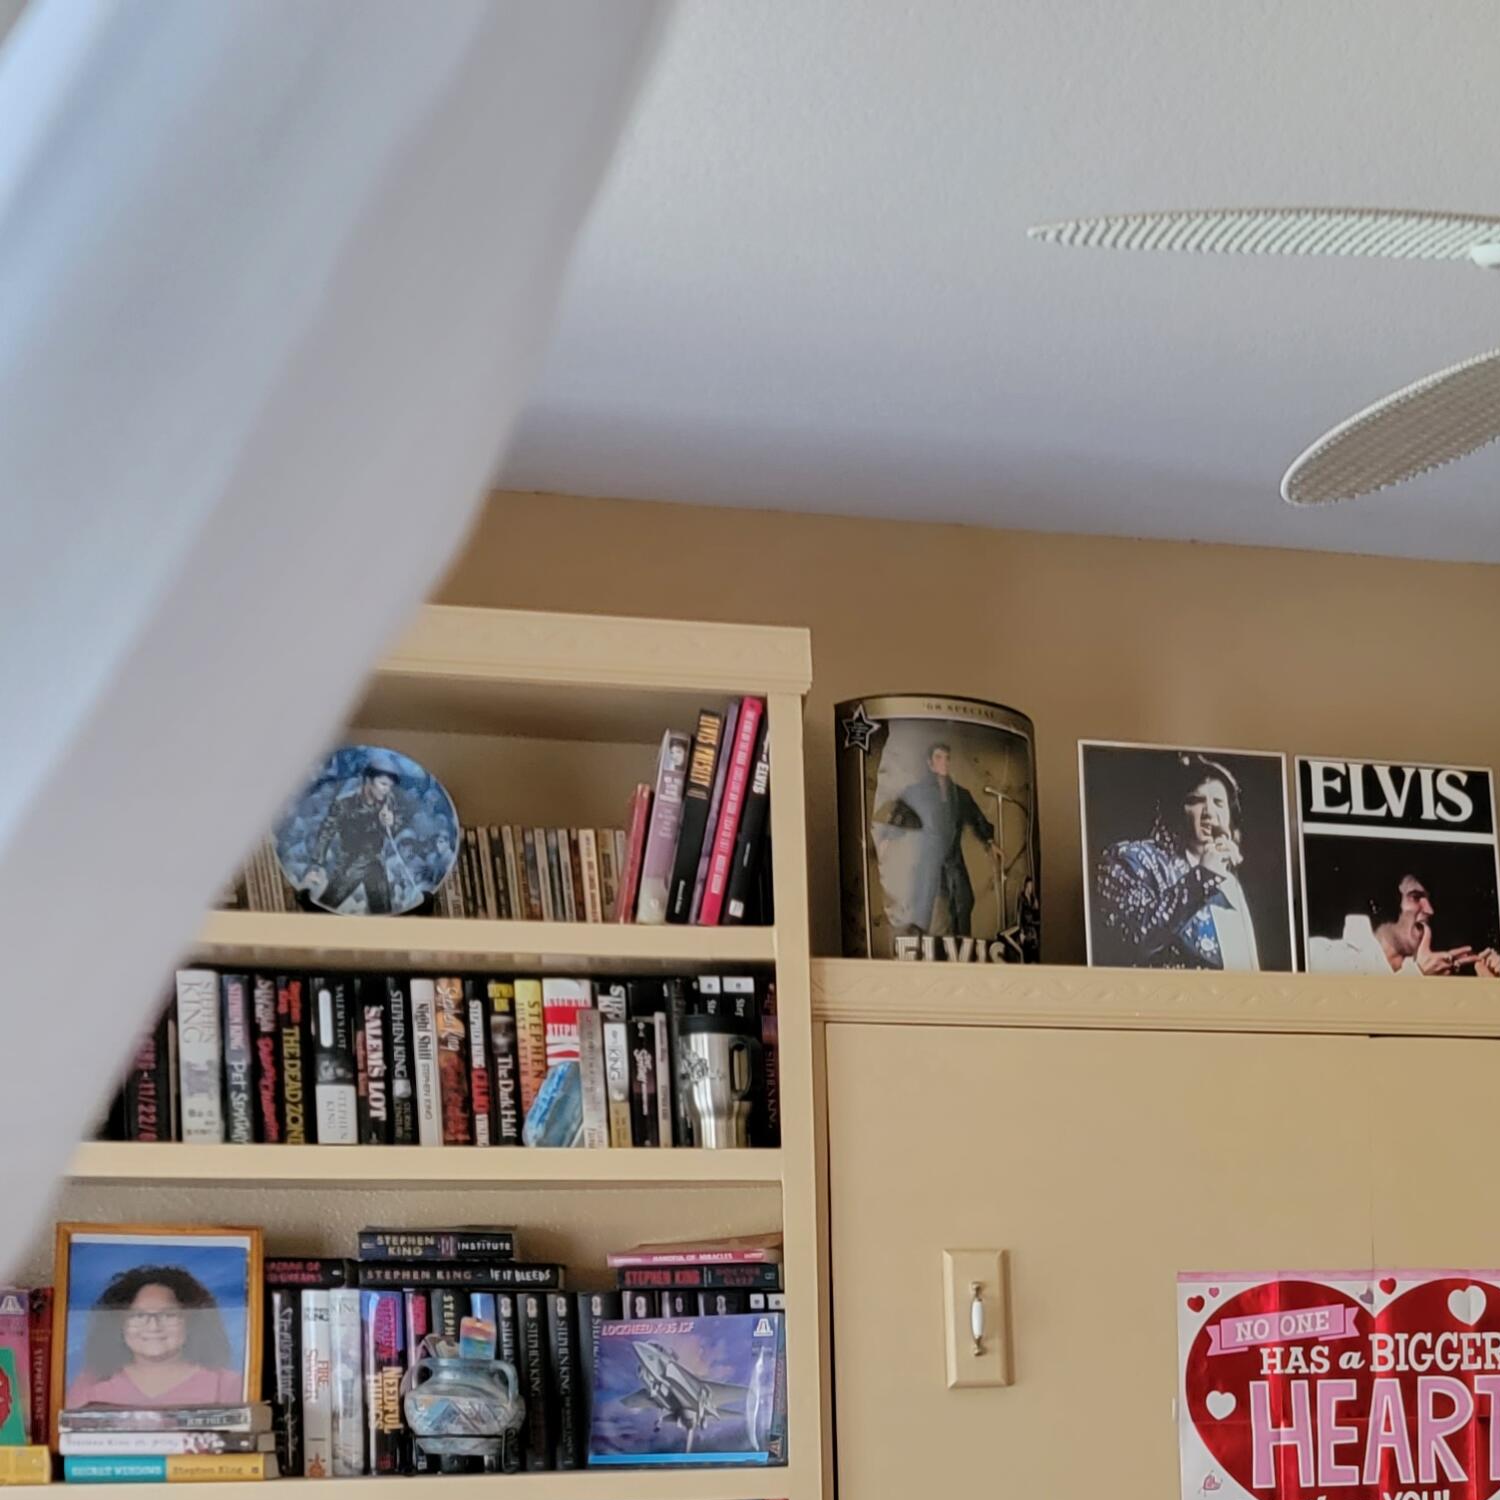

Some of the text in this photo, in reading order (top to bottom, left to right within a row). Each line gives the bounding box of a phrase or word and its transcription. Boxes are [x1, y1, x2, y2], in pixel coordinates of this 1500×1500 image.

[753, 763, 770, 795] ELVIS
[1307, 760, 1473, 823] ELVIS
[894, 936, 1006, 962] ELVIS
[181, 980, 201, 1044] KING
[414, 1002, 429, 1033] Night
[282, 1026, 300, 1057] THE
[390, 989, 407, 1080] STEPHEN KING
[526, 1000, 545, 1079] STEPHEN
[284, 1058, 302, 1100] DEAD
[609, 1048, 623, 1081] KING
[368, 1078, 386, 1121] LOT
[498, 1054, 517, 1137] The Dark Half
[377, 1235, 435, 1247] STEPHEN
[388, 1241, 511, 1257] KING INSTITUTE
[367, 1270, 430, 1281] STEPHEN
[436, 1270, 473, 1281] KING
[443, 1294, 455, 1336] STEPH
[1234, 1310, 1330, 1343] NO ONE
[317, 1360, 329, 1389] FIRE
[1259, 1346, 1330, 1375] HAS
[1338, 1351, 1365, 1370] a
[383, 1366, 403, 1434] NEEDFUL
